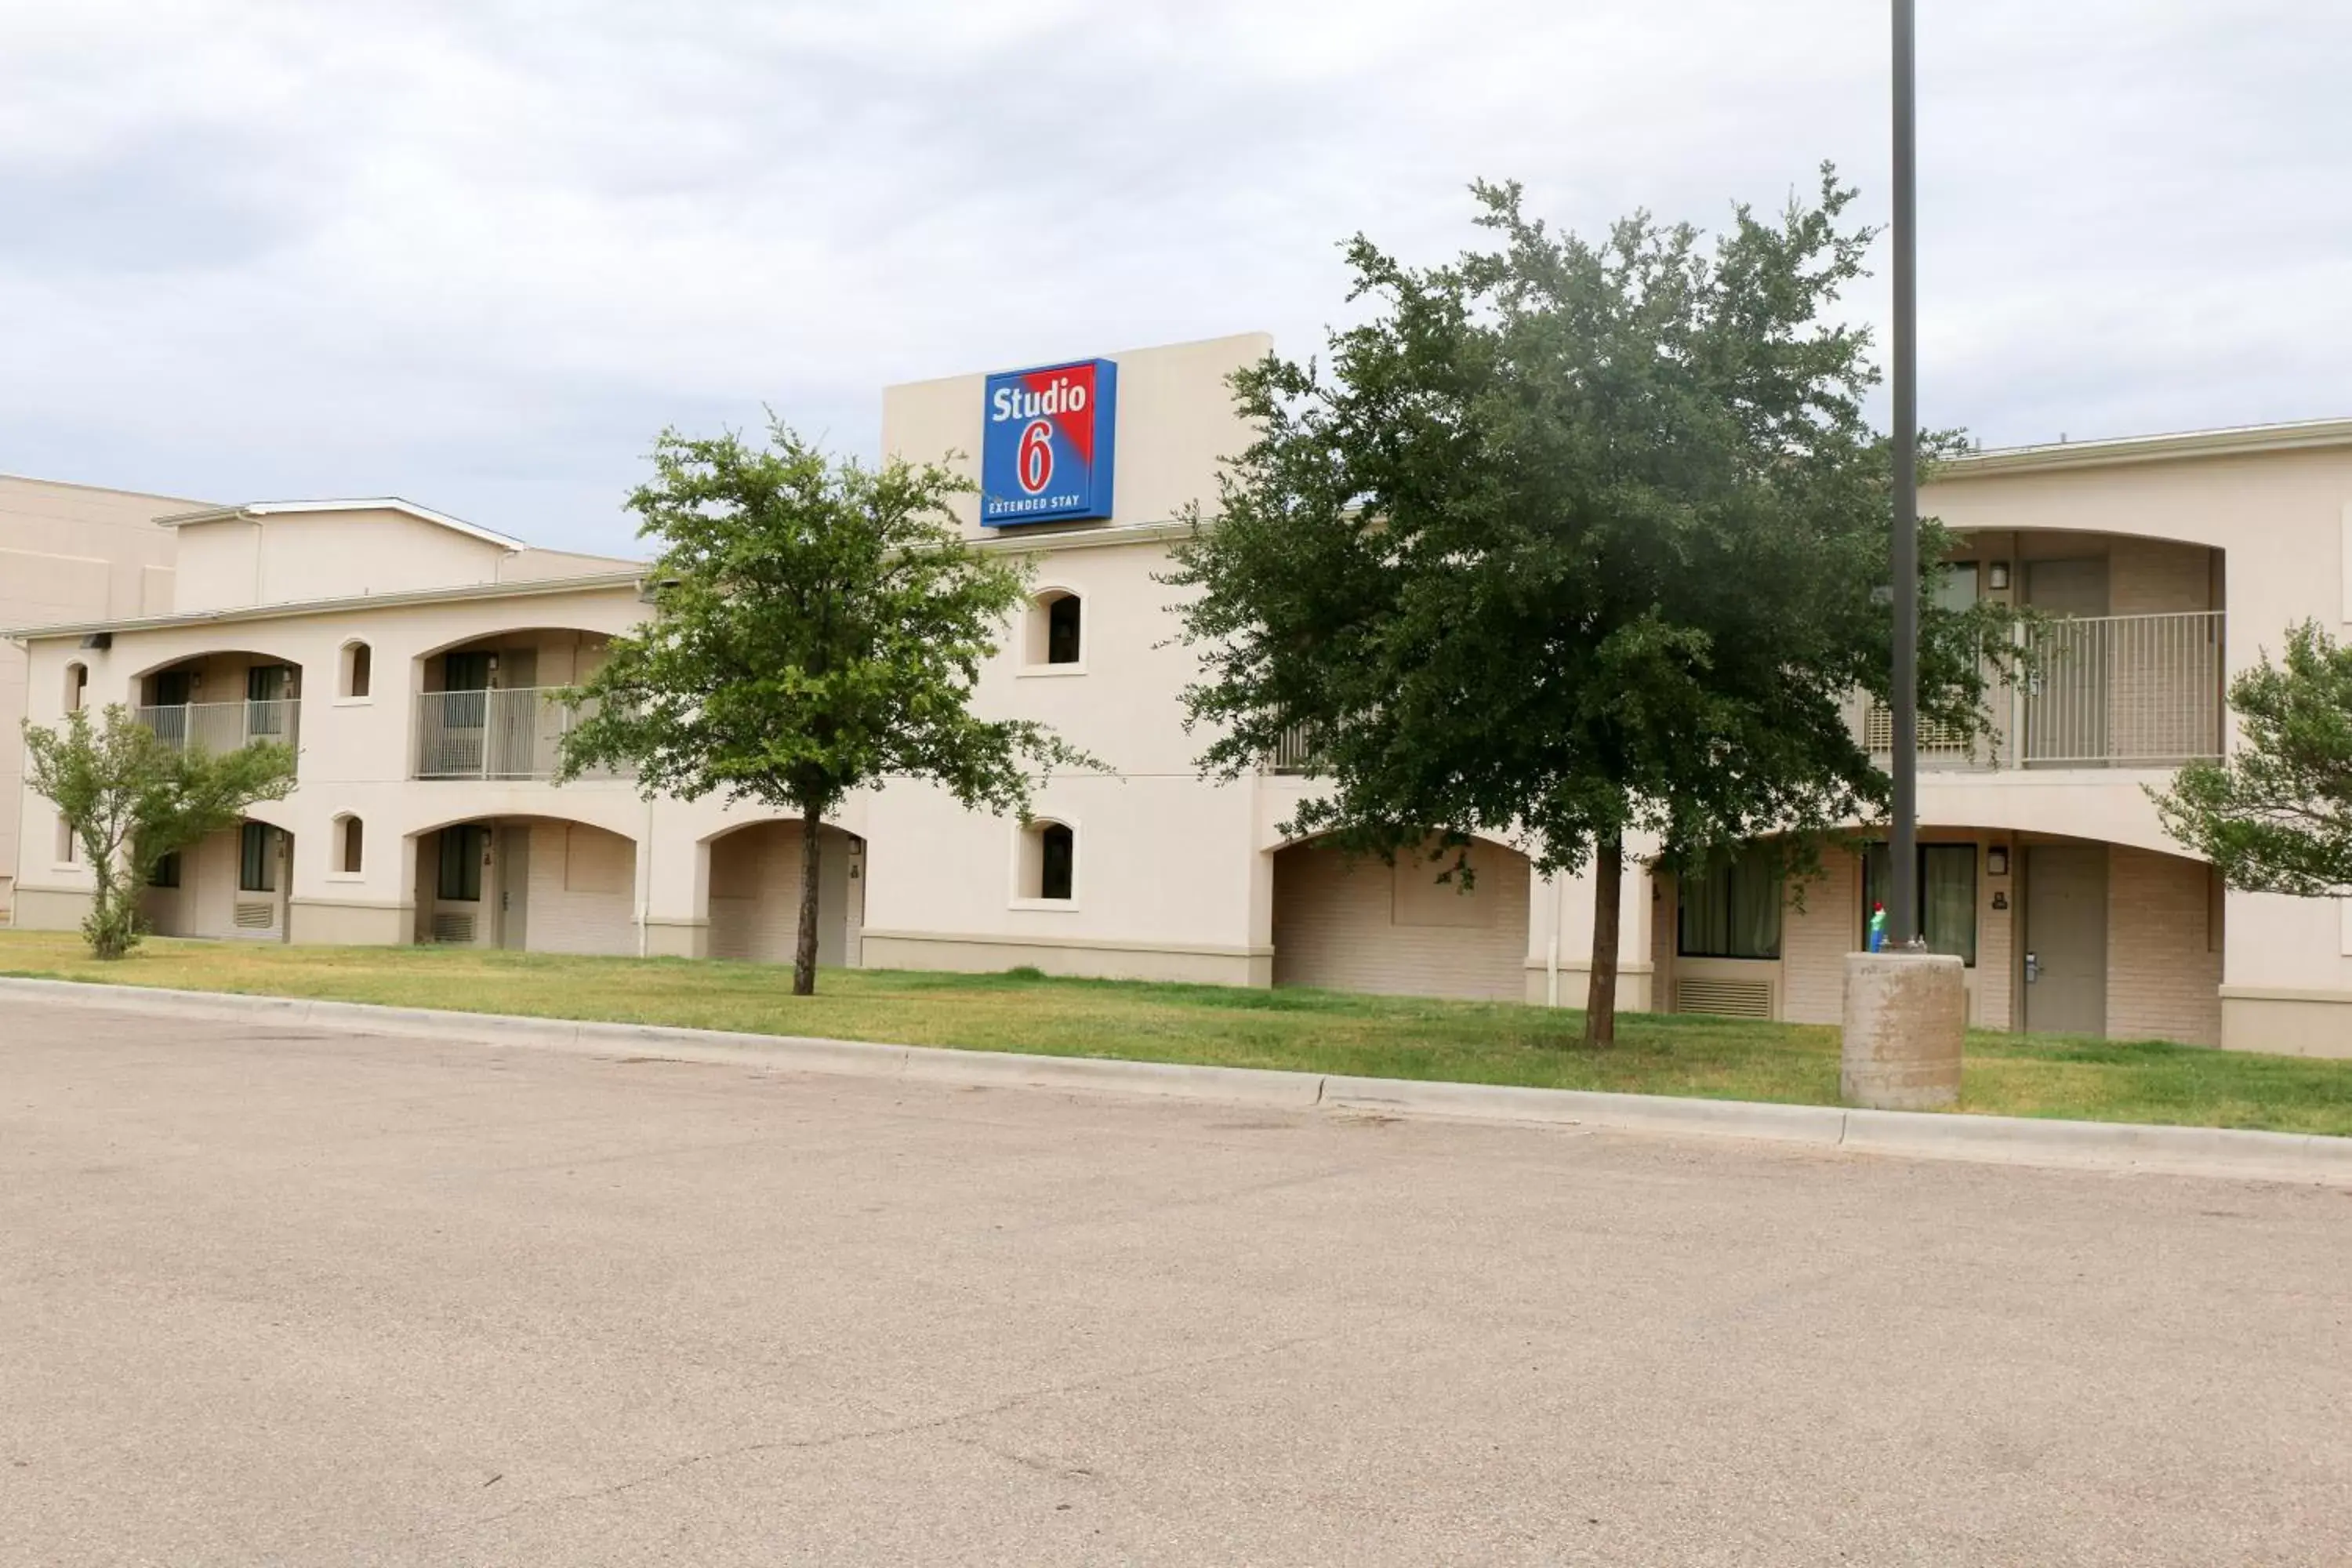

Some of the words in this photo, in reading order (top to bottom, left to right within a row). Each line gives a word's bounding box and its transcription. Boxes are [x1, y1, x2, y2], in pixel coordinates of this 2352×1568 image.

[993, 377, 1086, 421] Studio
[1018, 419, 1054, 495] 6
[989, 498, 1047, 514] EXTENDED
[1051, 495, 1080, 508] STAY
